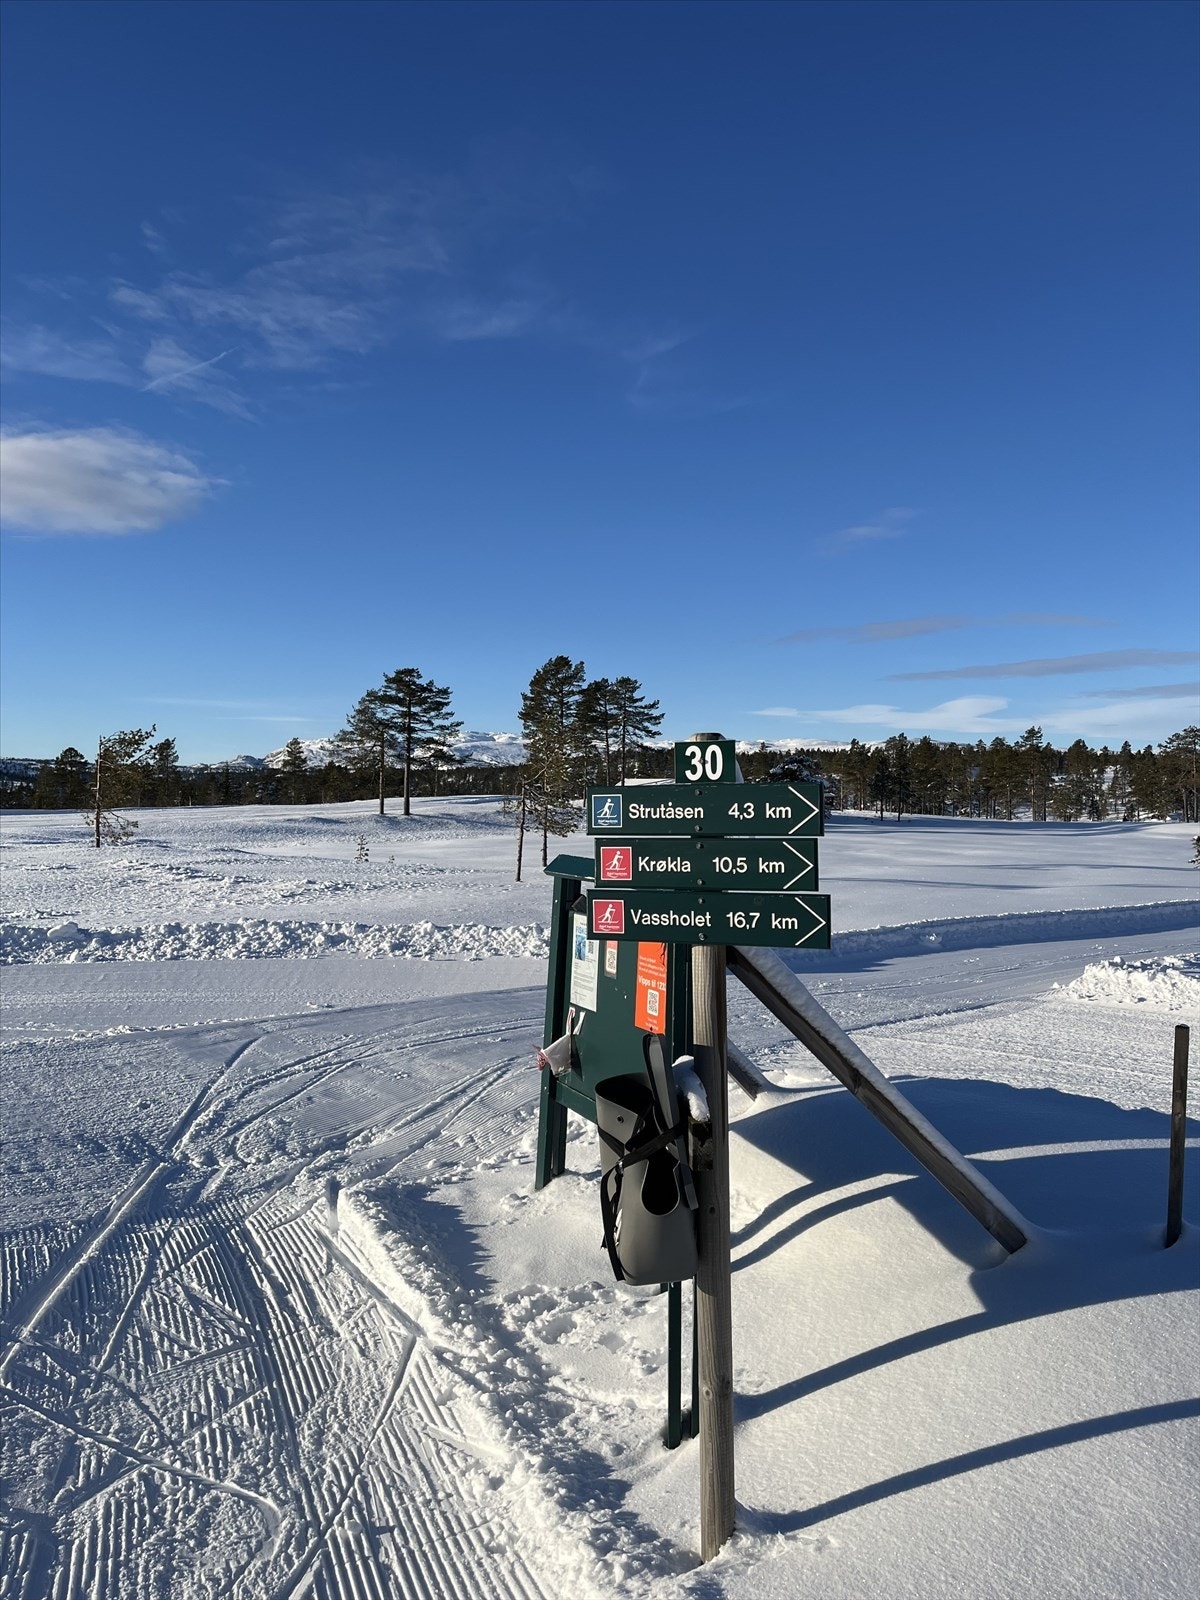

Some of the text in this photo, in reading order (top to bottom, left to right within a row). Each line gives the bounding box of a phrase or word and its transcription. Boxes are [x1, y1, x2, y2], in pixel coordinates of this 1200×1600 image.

[685, 745, 723, 781] 30
[628, 802, 791, 820] Strutåsen 4,3 km
[638, 856, 785, 875] Krøkla 10,5 km
[630, 908, 798, 930] Vassholet 16,7 km
